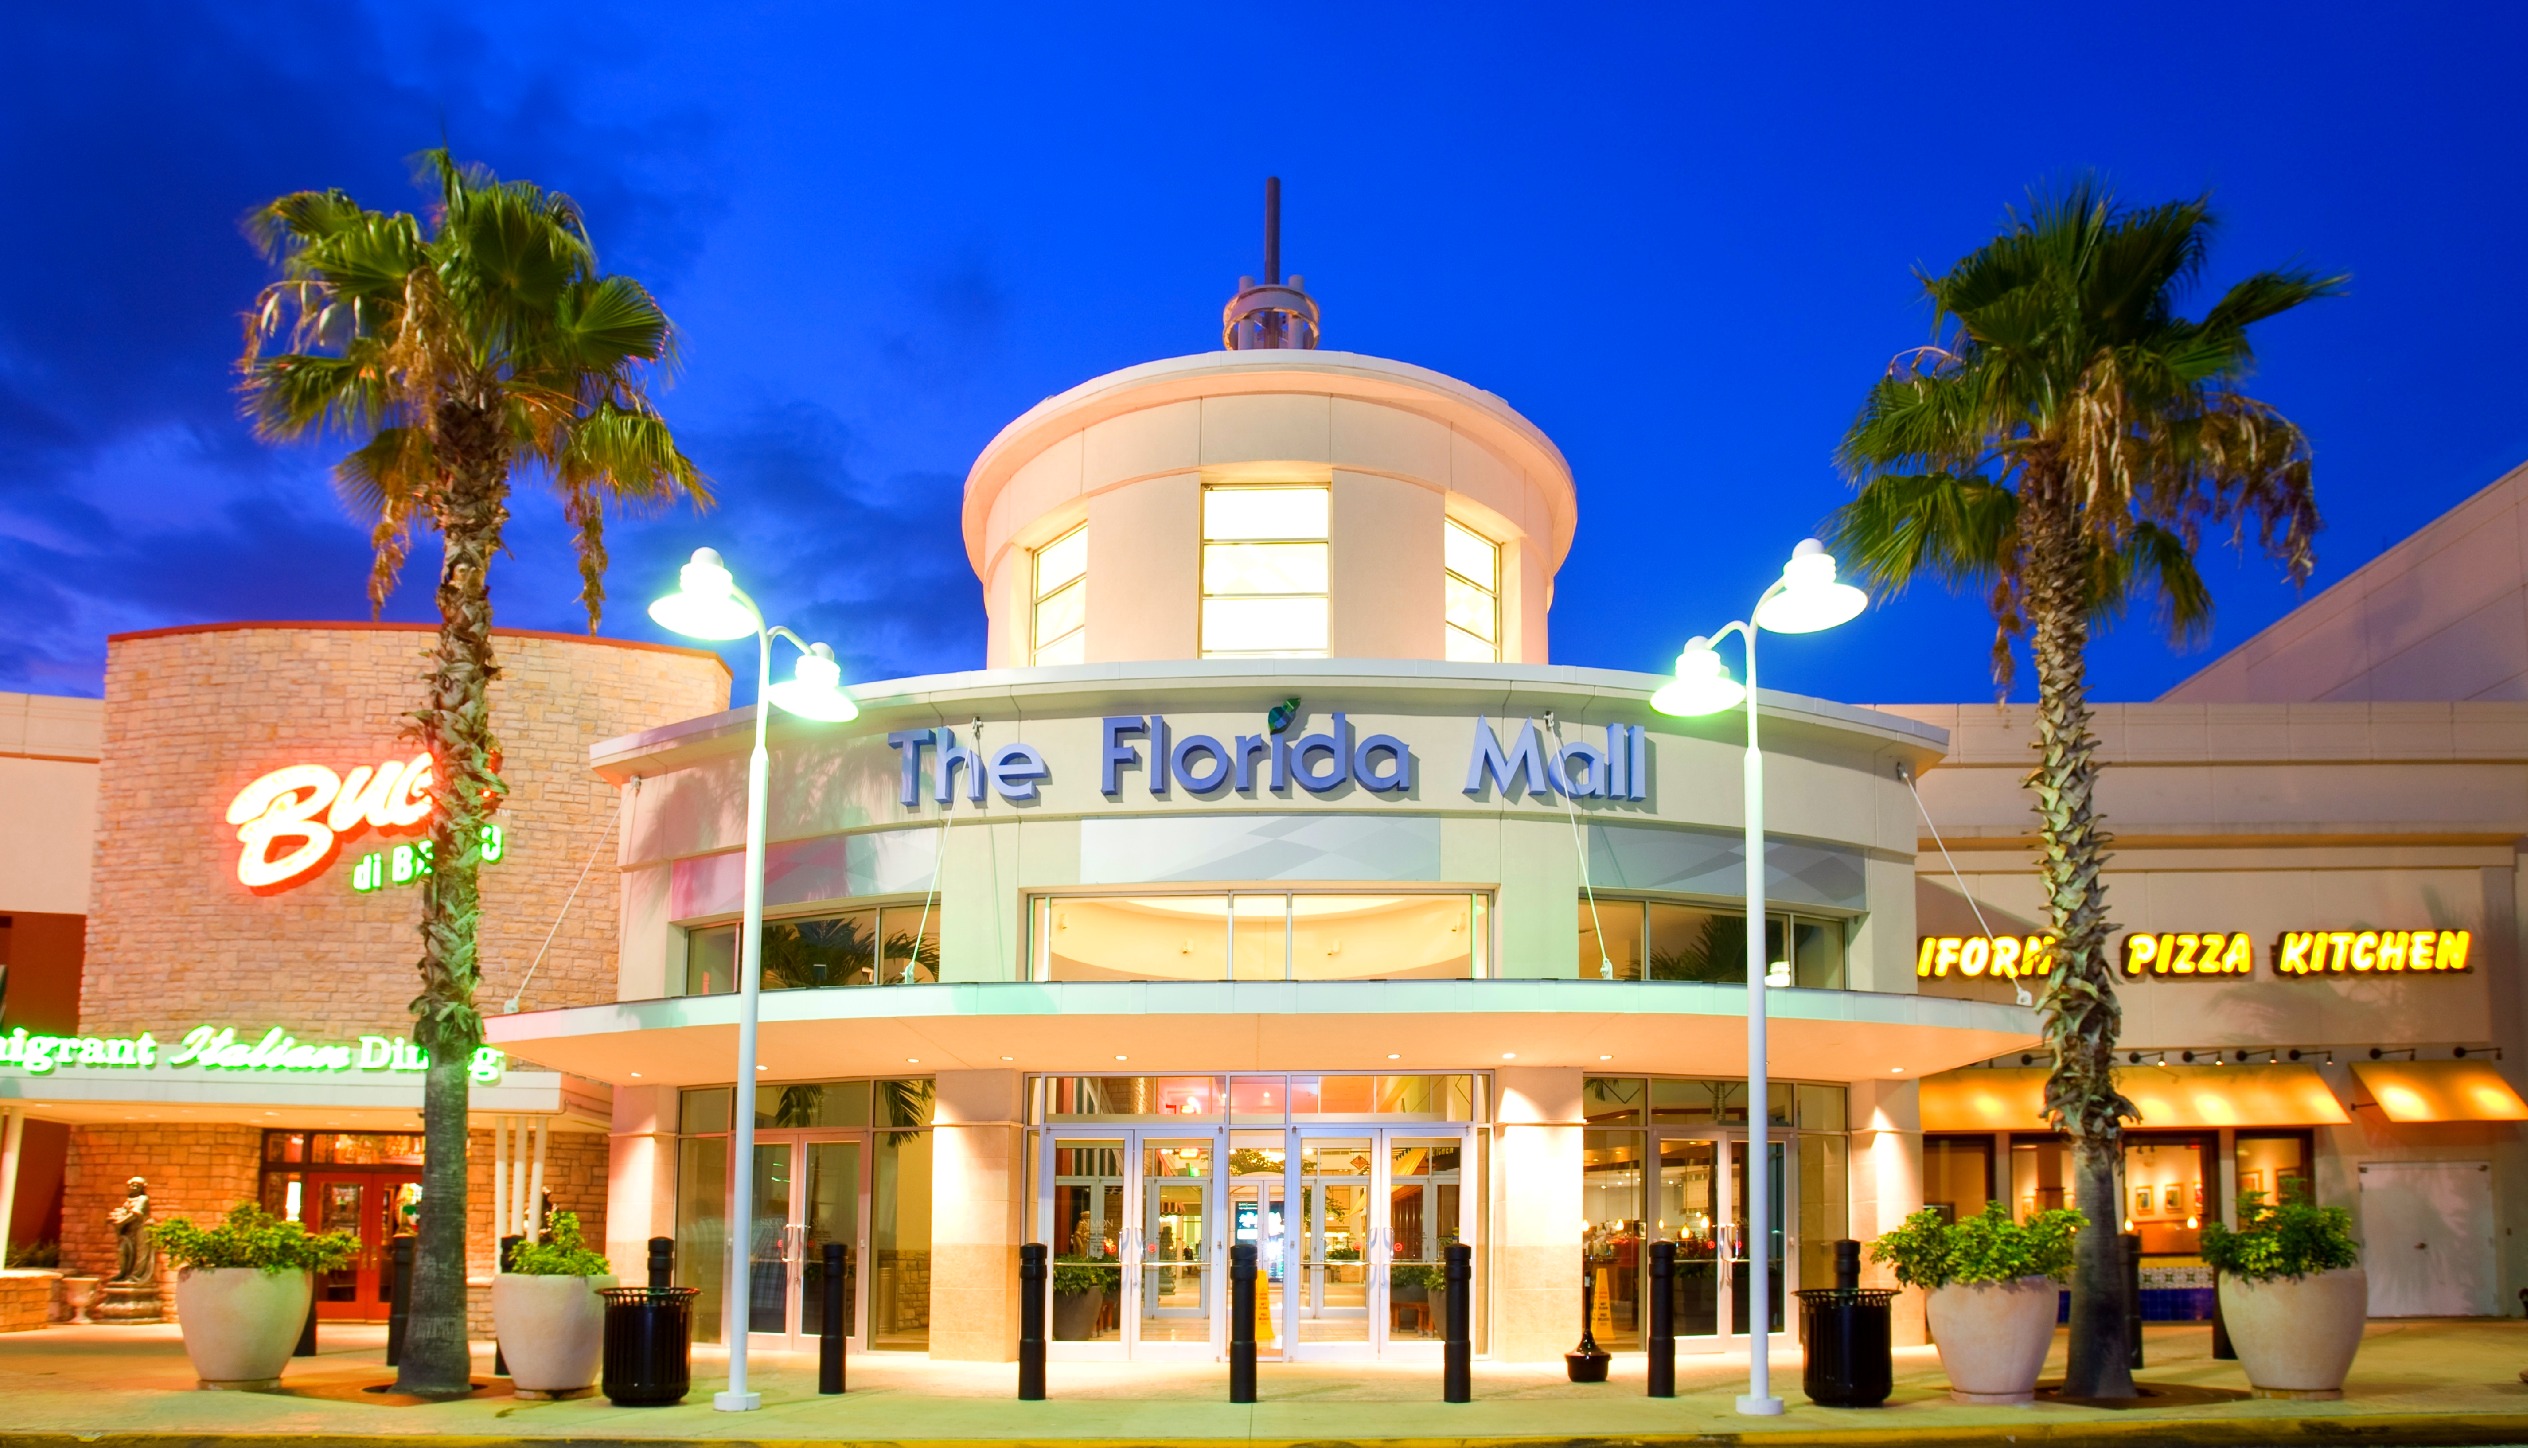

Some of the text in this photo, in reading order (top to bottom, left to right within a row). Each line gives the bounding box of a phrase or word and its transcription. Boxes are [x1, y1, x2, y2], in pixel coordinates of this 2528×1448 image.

[888, 712, 1647, 806] The Florida Mall
[226, 750, 502, 892] Buc
[1917, 930, 2471, 977] IFORN PIZZA KITCHEN
[167, 1024, 352, 1073] Italian
